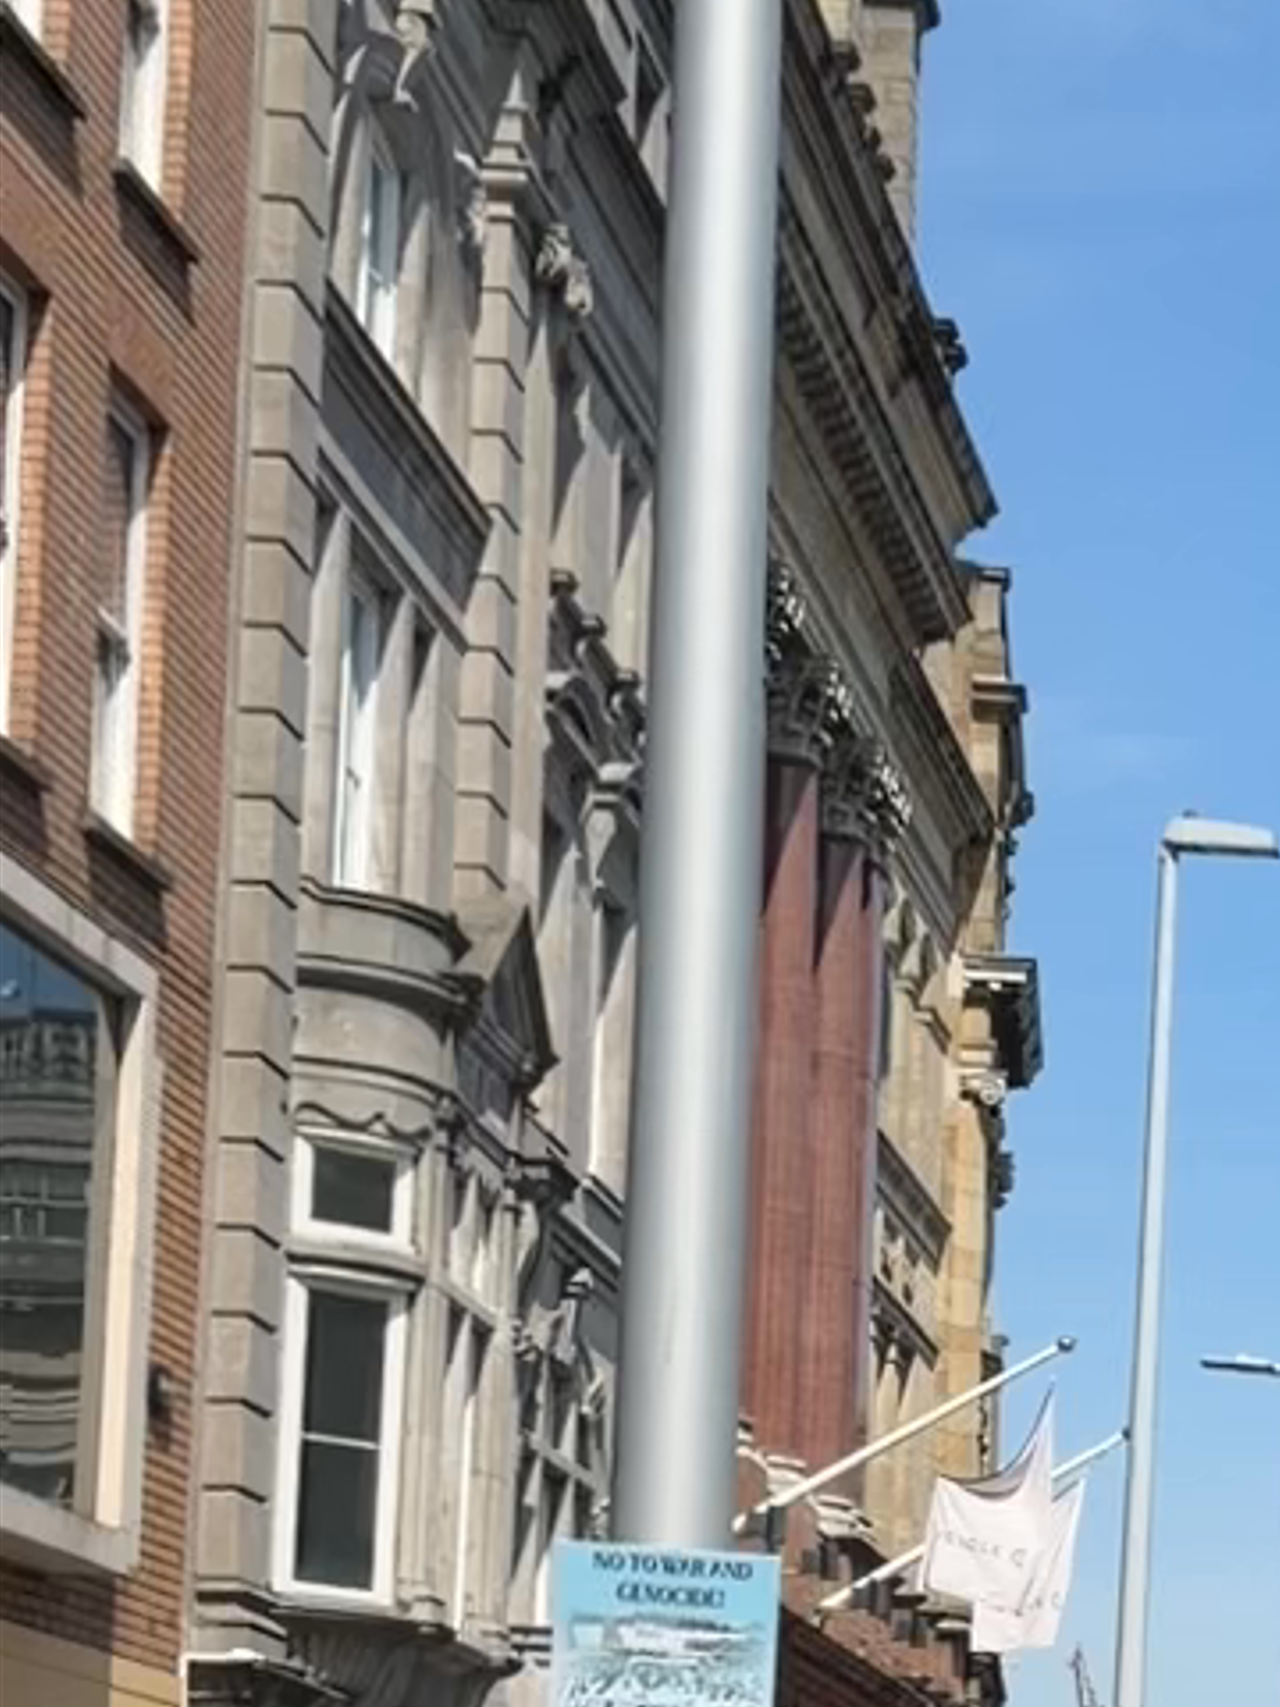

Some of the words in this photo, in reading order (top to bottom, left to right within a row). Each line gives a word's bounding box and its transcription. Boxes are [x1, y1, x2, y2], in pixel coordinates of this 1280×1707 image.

[593, 1551, 625, 1571] NO
[628, 1554, 657, 1574] TO
[660, 1556, 706, 1578] WAR
[709, 1562, 753, 1581] AND
